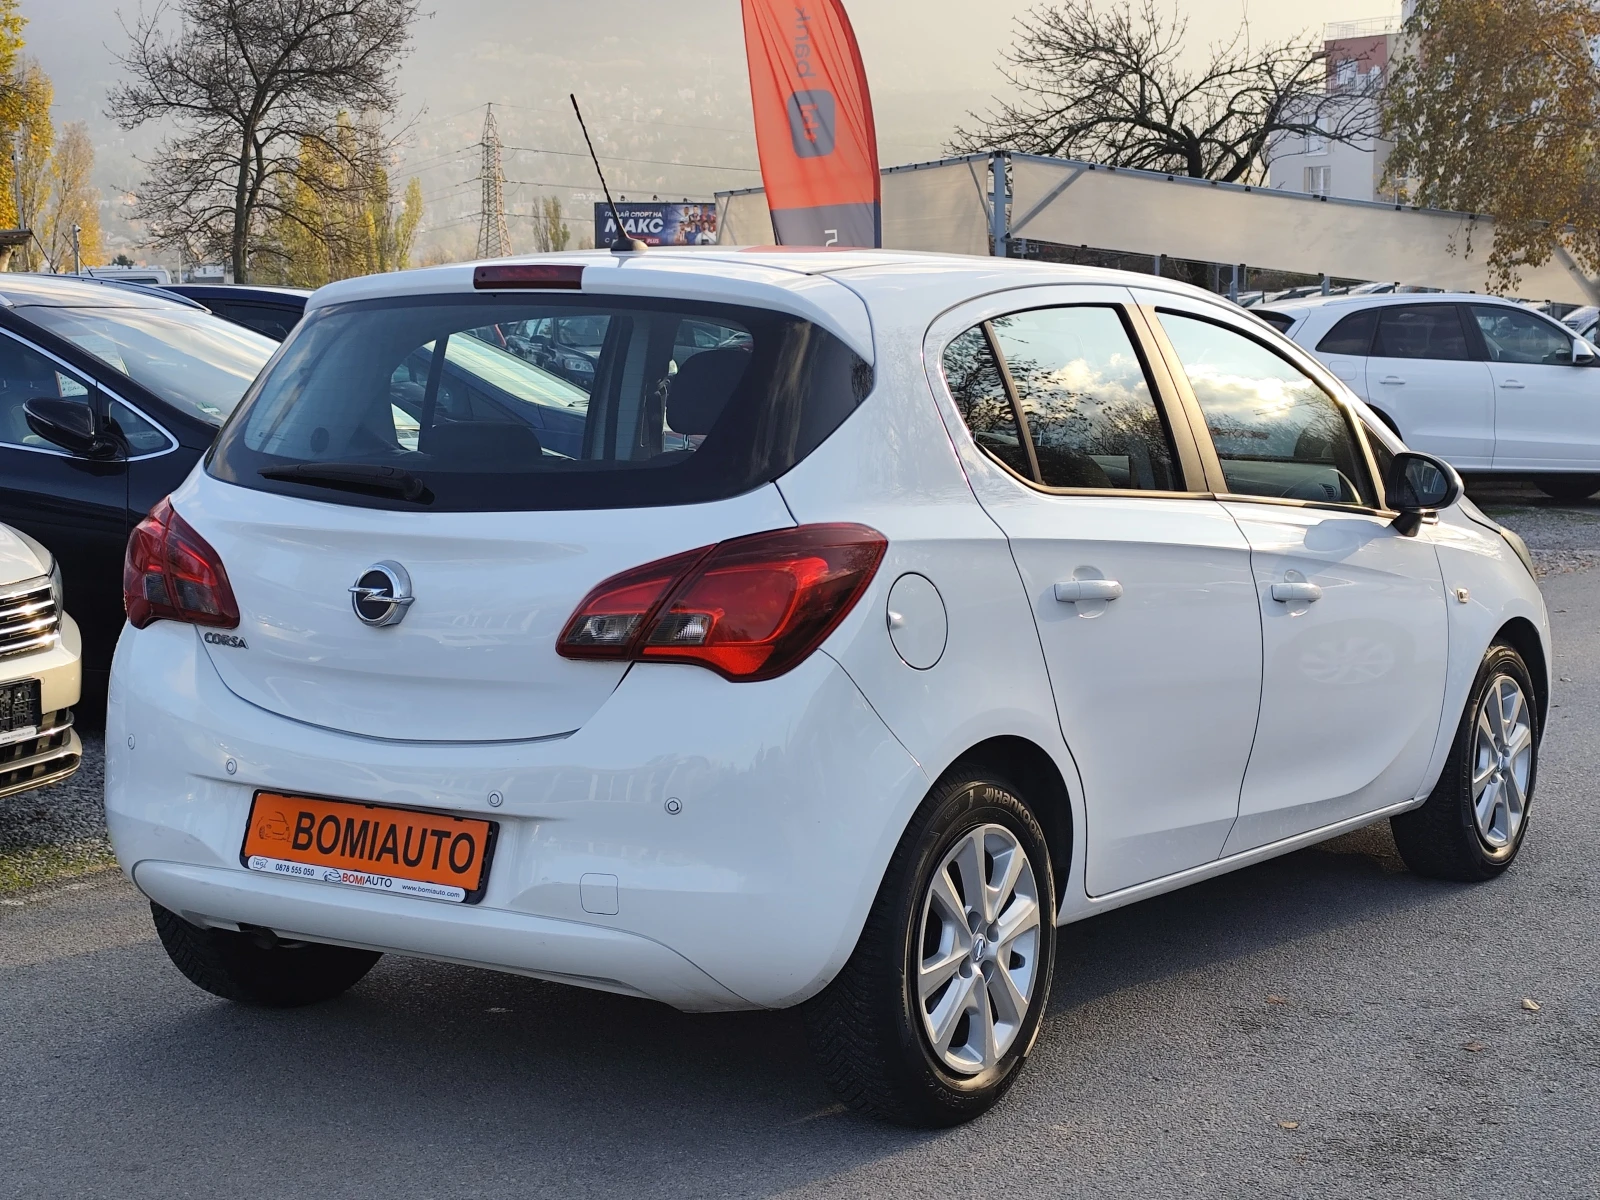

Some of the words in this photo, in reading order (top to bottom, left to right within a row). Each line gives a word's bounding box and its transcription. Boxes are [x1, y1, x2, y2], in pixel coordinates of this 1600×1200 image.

[604, 210, 630, 218] ГЛДАЙ
[604, 218, 664, 233] МАКС
[204, 631, 249, 649] CORSA
[291, 811, 476, 875] BOMIAUTO
[275, 863, 290, 873] 0878
[290, 865, 302, 875] 555
[302, 867, 315, 877] 050
[341, 872, 393, 888] BOMIAUTO
[402, 884, 460, 898] www.bomiauto.com
